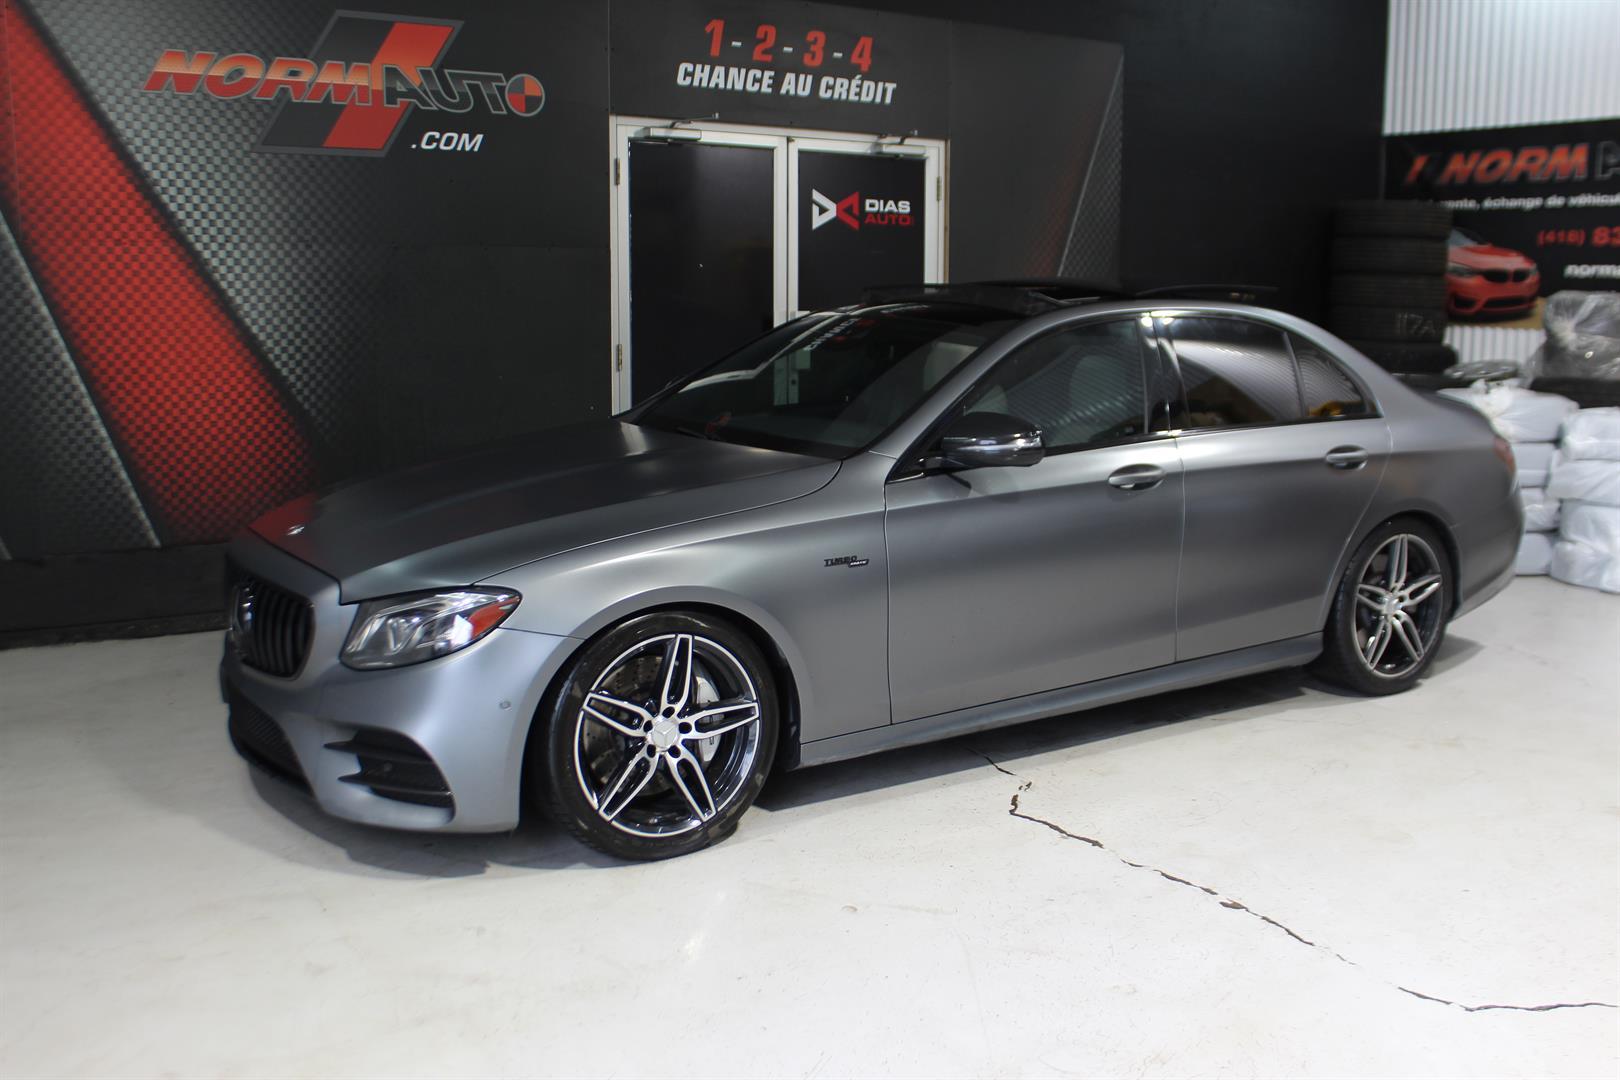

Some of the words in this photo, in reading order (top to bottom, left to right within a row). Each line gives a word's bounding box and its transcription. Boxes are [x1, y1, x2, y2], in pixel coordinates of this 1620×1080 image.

[677, 62, 775, 95] CHANCE
[780, 73, 813, 97] AU
[818, 76, 897, 105] CRÉDIT
[411, 131, 483, 152] .COM
[865, 198, 911, 214] DIAS
[1482, 195, 1543, 211] échange
[1544, 194, 1566, 209] de
[864, 214, 912, 227] AUTO
